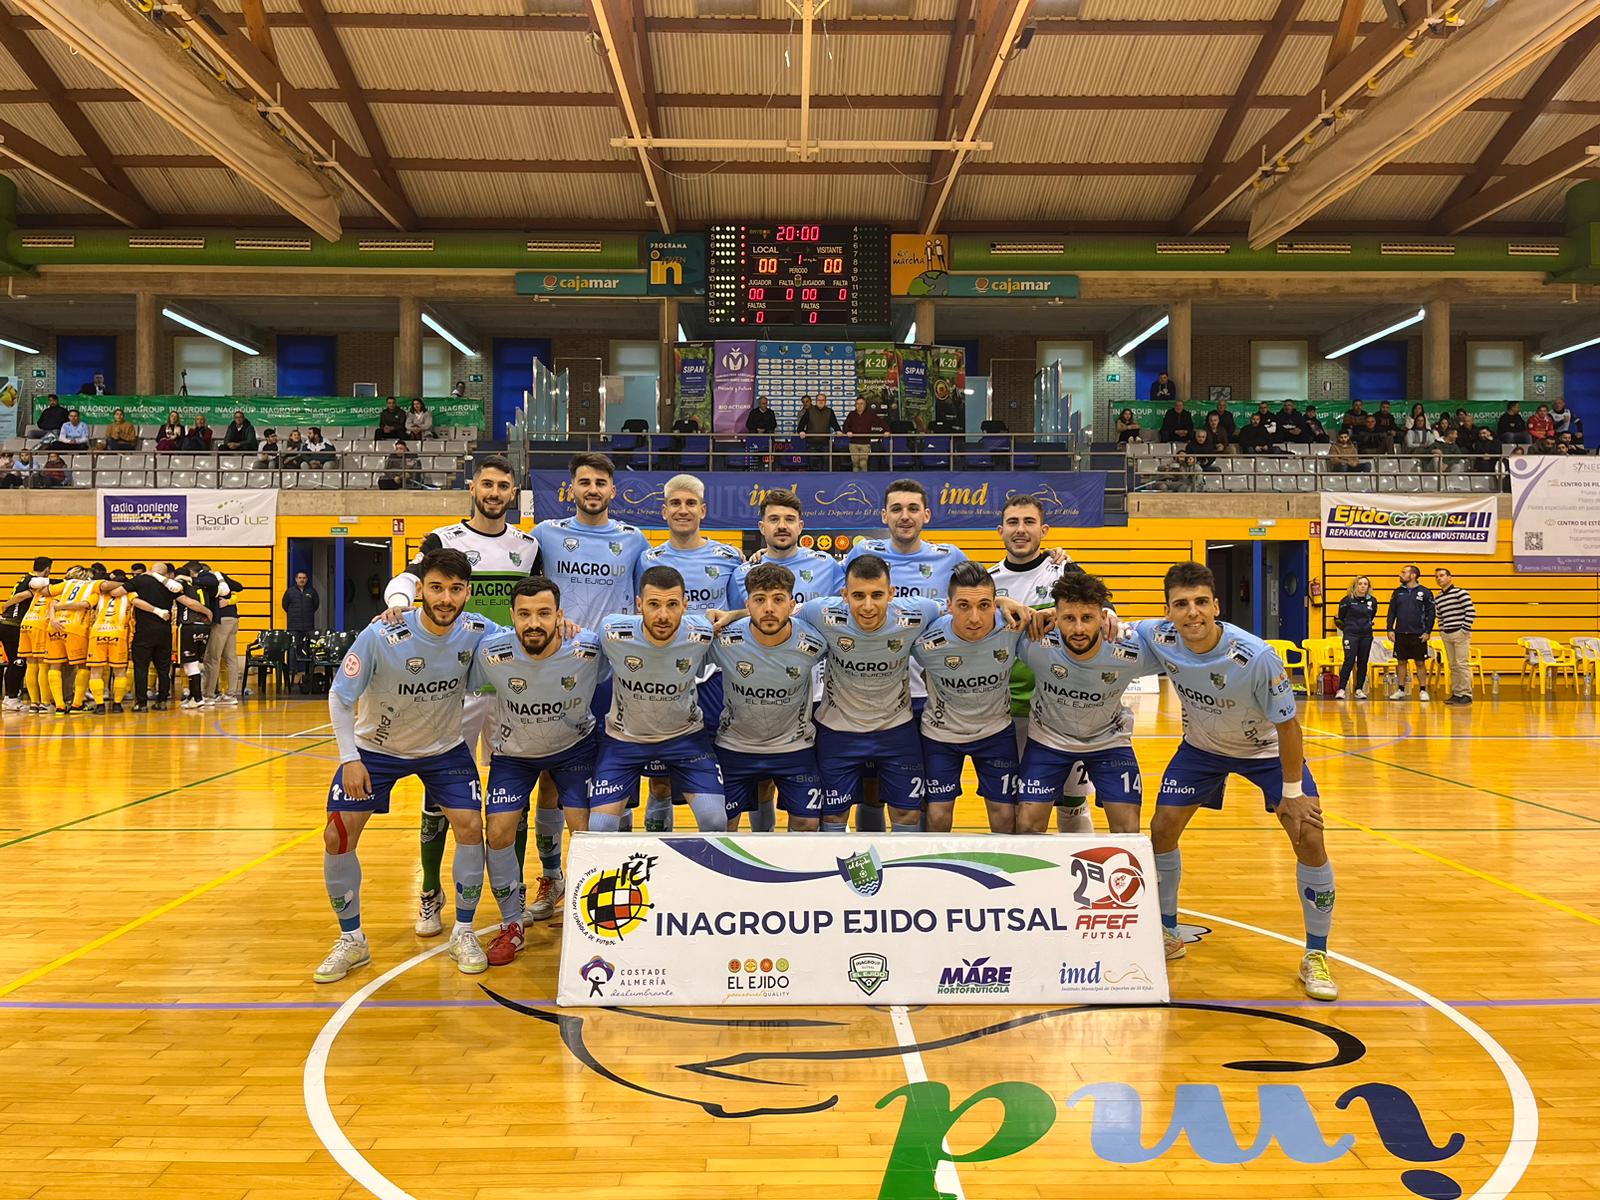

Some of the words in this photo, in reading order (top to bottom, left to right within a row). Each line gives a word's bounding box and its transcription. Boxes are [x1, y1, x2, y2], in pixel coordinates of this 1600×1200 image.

[776, 226, 820, 241] 20:00
[752, 246, 779, 254] LOCAL
[816, 246, 843, 254] VISITANTE
[893, 252, 925, 265] marcha
[758, 258, 777, 273] 00
[823, 258, 842, 273] 00
[559, 275, 619, 292] cajamar
[991, 277, 1051, 294] cajamar
[748, 288, 764, 300] 00
[786, 288, 794, 300] 0
[801, 288, 817, 300] 00
[838, 288, 847, 300] 0
[756, 311, 764, 323] 0
[809, 311, 817, 323] 0
[865, 358, 887, 368] K-20
[939, 358, 958, 368] K-20
[682, 366, 705, 374] SIPAN
[905, 367, 925, 375] SIPAN
[124, 405, 165, 413] INAGROUP
[260, 406, 301, 414] INAGROUP
[439, 404, 479, 413] INAGROUP
[939, 482, 988, 506] imd
[110, 502, 134, 512] radio
[137, 502, 179, 514] poniente
[196, 514, 240, 525] Radio
[1334, 504, 1448, 528] Ejidocam
[1447, 515, 1466, 525] S.L.
[1328, 528, 1376, 538] REPARACIÓN
[1377, 530, 1388, 538] DE
[1388, 529, 1431, 540] VEHÍCULOS
[1432, 531, 1486, 541] INDUSTRIALES
[557, 560, 625, 577] INAGROUP
[570, 576, 582, 584] EL
[585, 577, 614, 586] EJIDO
[68, 586, 80, 601] 8
[196, 588, 205, 606] 1
[940, 671, 1008, 688] INAGROU
[398, 677, 462, 696] INAGRO
[1043, 681, 1120, 703] INAGROUP
[413, 695, 429, 703] EL
[632, 693, 646, 701] EL
[649, 694, 681, 702] EJIDO
[745, 697, 757, 705] EL
[760, 697, 791, 706] EJIDO
[1057, 697, 1071, 707] EL
[1072, 699, 1105, 709] EJIDO
[506, 696, 582, 716] INAGROUP
[520, 716, 534, 724] EL
[595, 779, 608, 787] La
[926, 778, 939, 787] La
[1027, 778, 1040, 787] La
[1120, 771, 1142, 794] 14
[1164, 777, 1177, 786] La
[493, 787, 506, 795] La
[826, 789, 838, 797] La
[1070, 858, 1104, 906] 2ª
[656, 910, 834, 937] INAGROUP
[843, 908, 938, 934] EJIDO
[946, 907, 1068, 932] FUTSAL
[1082, 931, 1131, 939] FUTSAL
[1059, 961, 1101, 984] imd
[620, 977, 666, 986] ALMERÍA
[727, 976, 743, 989] EL
[748, 975, 790, 989] EJIDO
